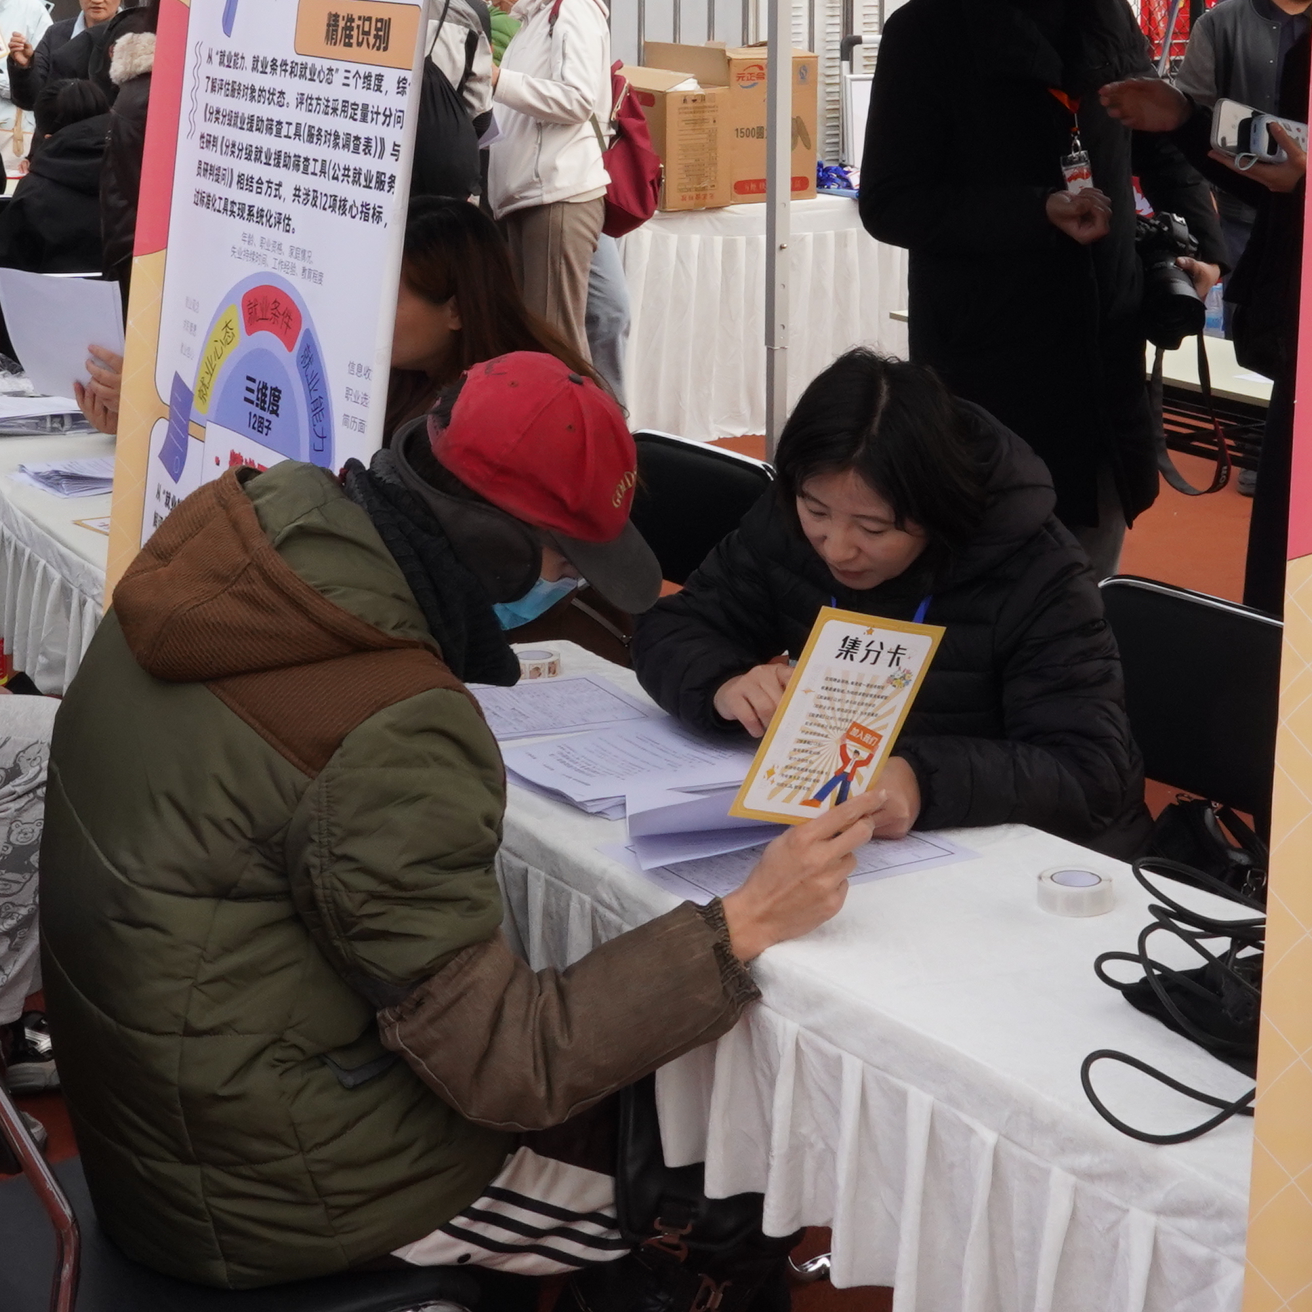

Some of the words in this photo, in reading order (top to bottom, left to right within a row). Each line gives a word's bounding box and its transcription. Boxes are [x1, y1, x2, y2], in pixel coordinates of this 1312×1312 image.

[324, 10, 390, 52] 精准识别
[206, 47, 411, 97] 从“就业能力、就业条件和就业心态”三个维度，综
[246, 295, 294, 337] 就业条件
[198, 318, 236, 405] 就业心态
[244, 375, 282, 418] 三维度
[300, 342, 325, 454] 就业能力
[248, 410, 273, 437] 12因子
[835, 635, 908, 669] 集分卡
